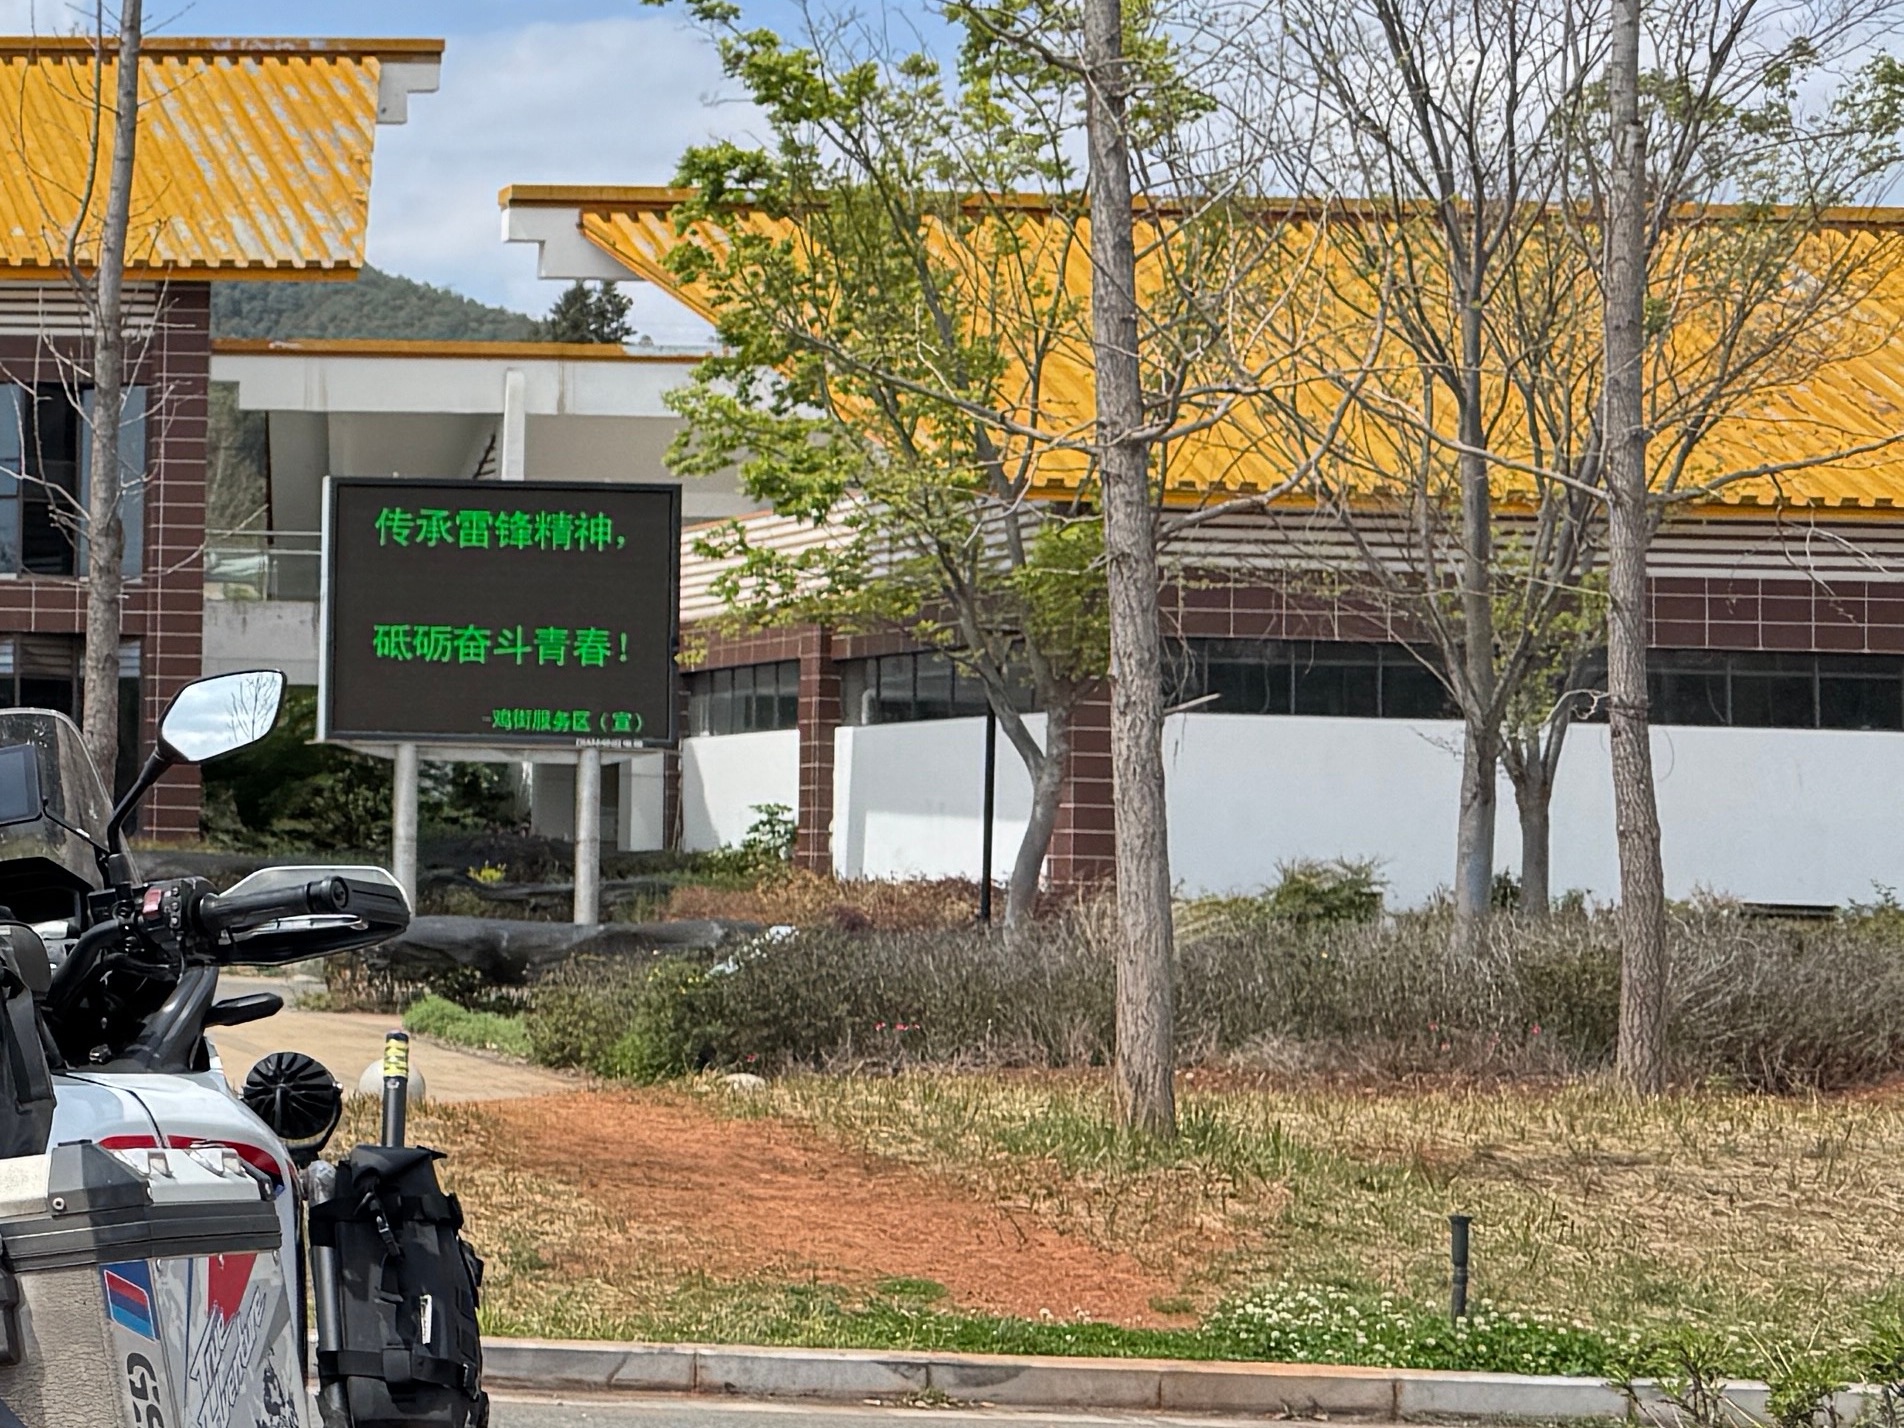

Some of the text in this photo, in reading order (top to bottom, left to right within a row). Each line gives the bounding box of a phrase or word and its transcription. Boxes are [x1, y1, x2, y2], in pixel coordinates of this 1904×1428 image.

[375, 506, 627, 551] 传承雷锋精神，
[373, 624, 629, 667] 砥砺奋斗青春！
